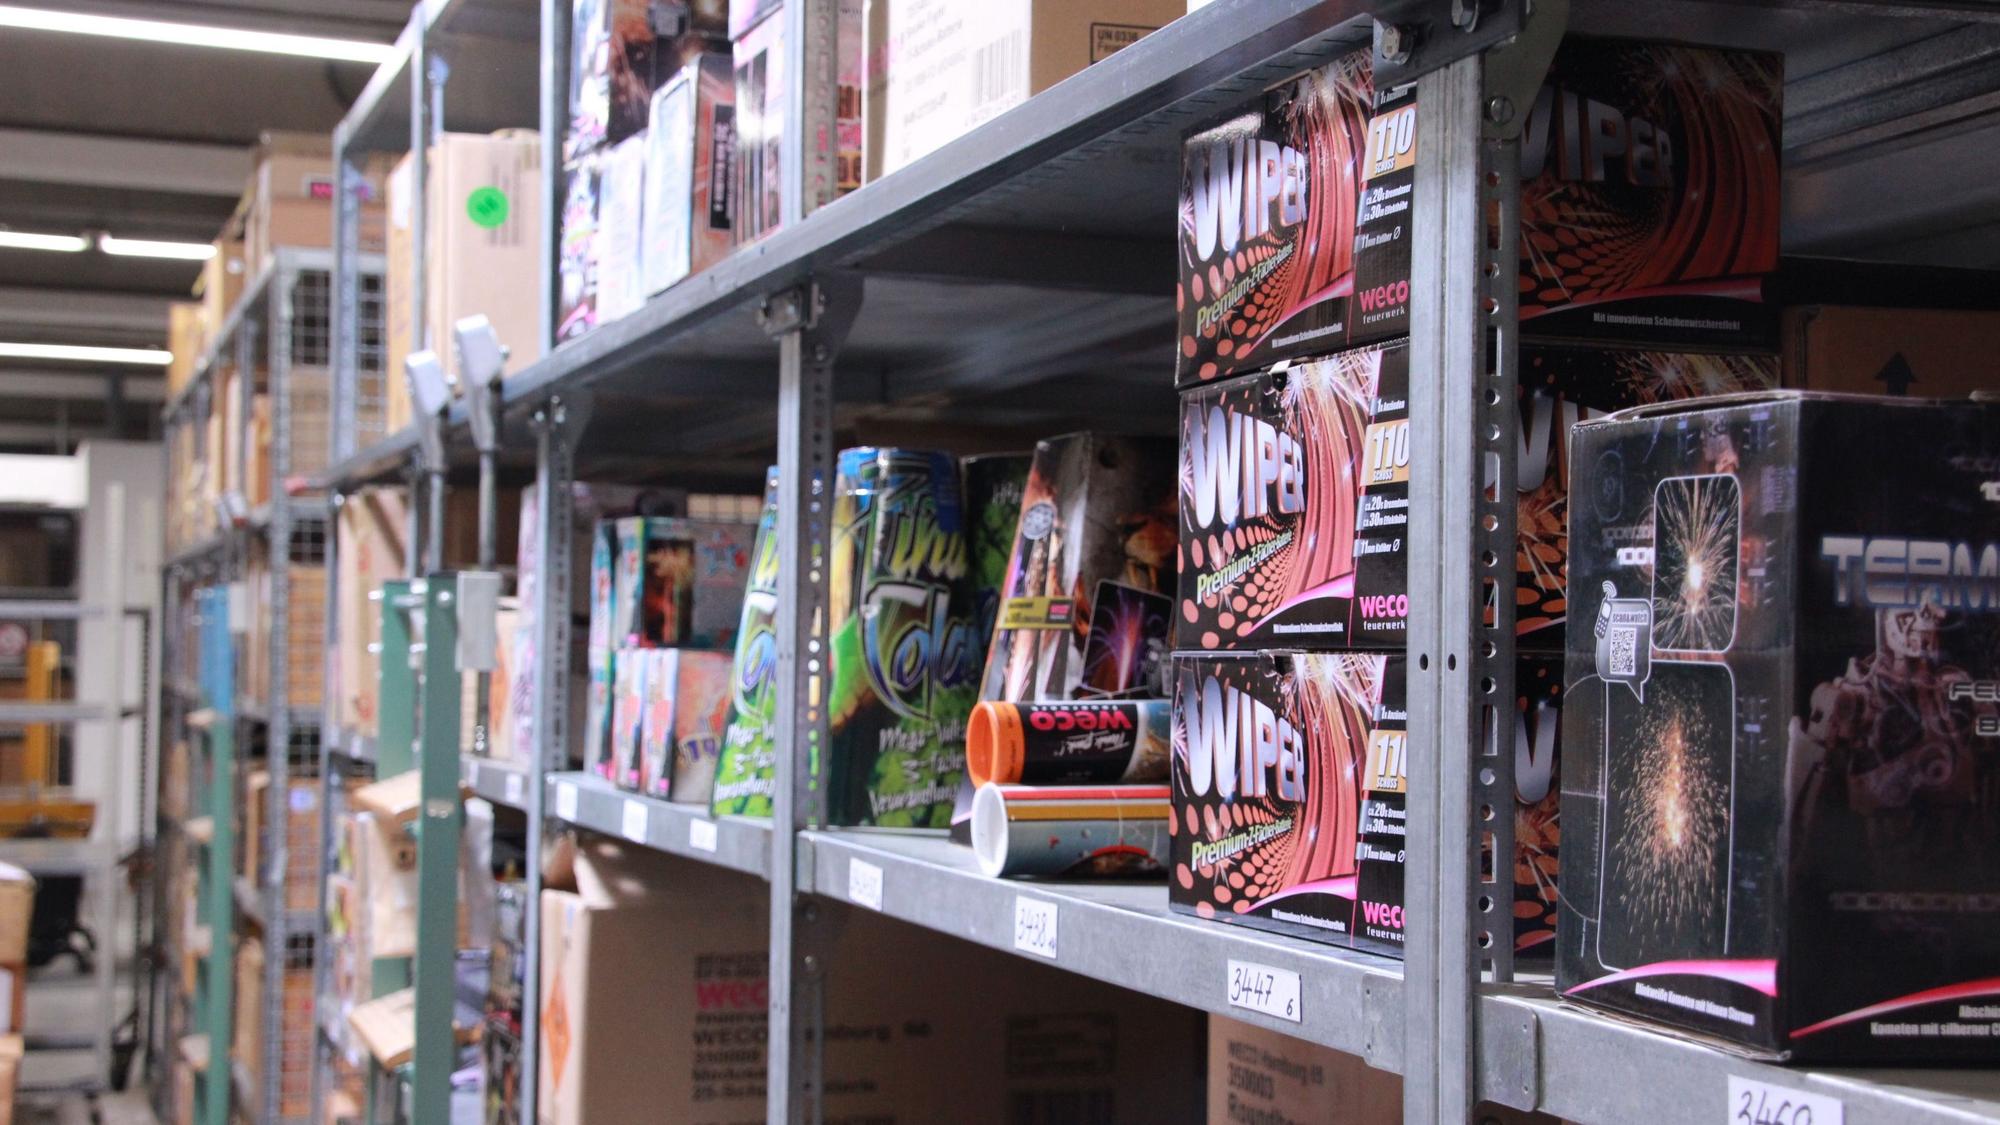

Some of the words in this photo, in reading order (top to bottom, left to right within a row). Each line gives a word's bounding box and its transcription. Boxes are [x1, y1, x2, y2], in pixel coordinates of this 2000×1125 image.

[1376, 107, 1416, 163] 110
[1191, 138, 1308, 262] WIPER
[1359, 280, 1409, 313] weco
[1363, 305, 1406, 325] feuerwerk
[1187, 404, 1306, 529] WIPER
[1374, 421, 1409, 472] 110
[1359, 594, 1408, 618] weco
[1363, 620, 1406, 631] feuerwerk
[1029, 710, 1133, 732] weco
[1182, 674, 1306, 802] WIPER
[1231, 967, 1274, 1006] 3447
[1286, 998, 1294, 1016] 6
[1870, 1022, 1919, 1036] Kometen
[1920, 1022, 1939, 1036] mit
[1940, 1022, 1990, 1036] silberner
